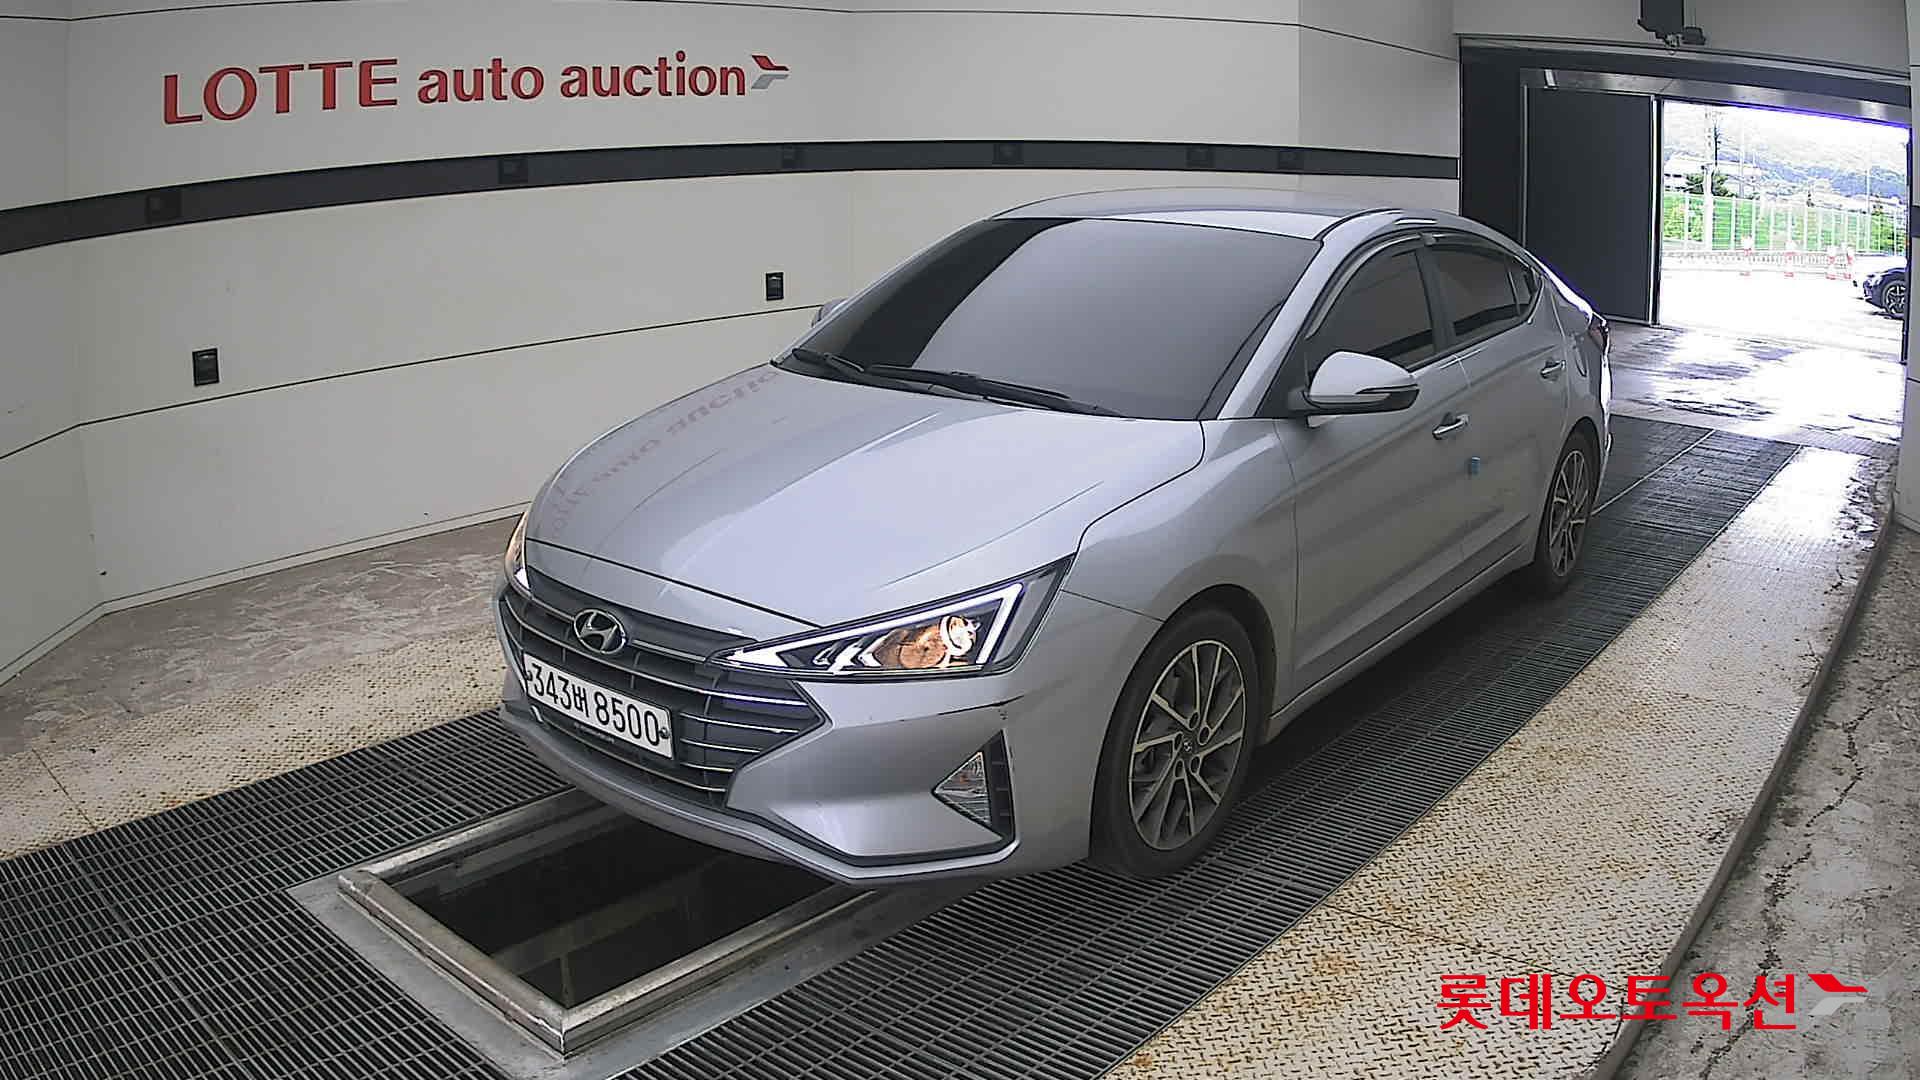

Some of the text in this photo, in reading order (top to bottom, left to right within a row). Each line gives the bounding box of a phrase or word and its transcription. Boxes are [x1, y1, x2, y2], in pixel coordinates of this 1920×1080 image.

[163, 50, 746, 125] LOTTE auto auction
[532, 663, 589, 717] 343버
[594, 691, 659, 746] 8500
